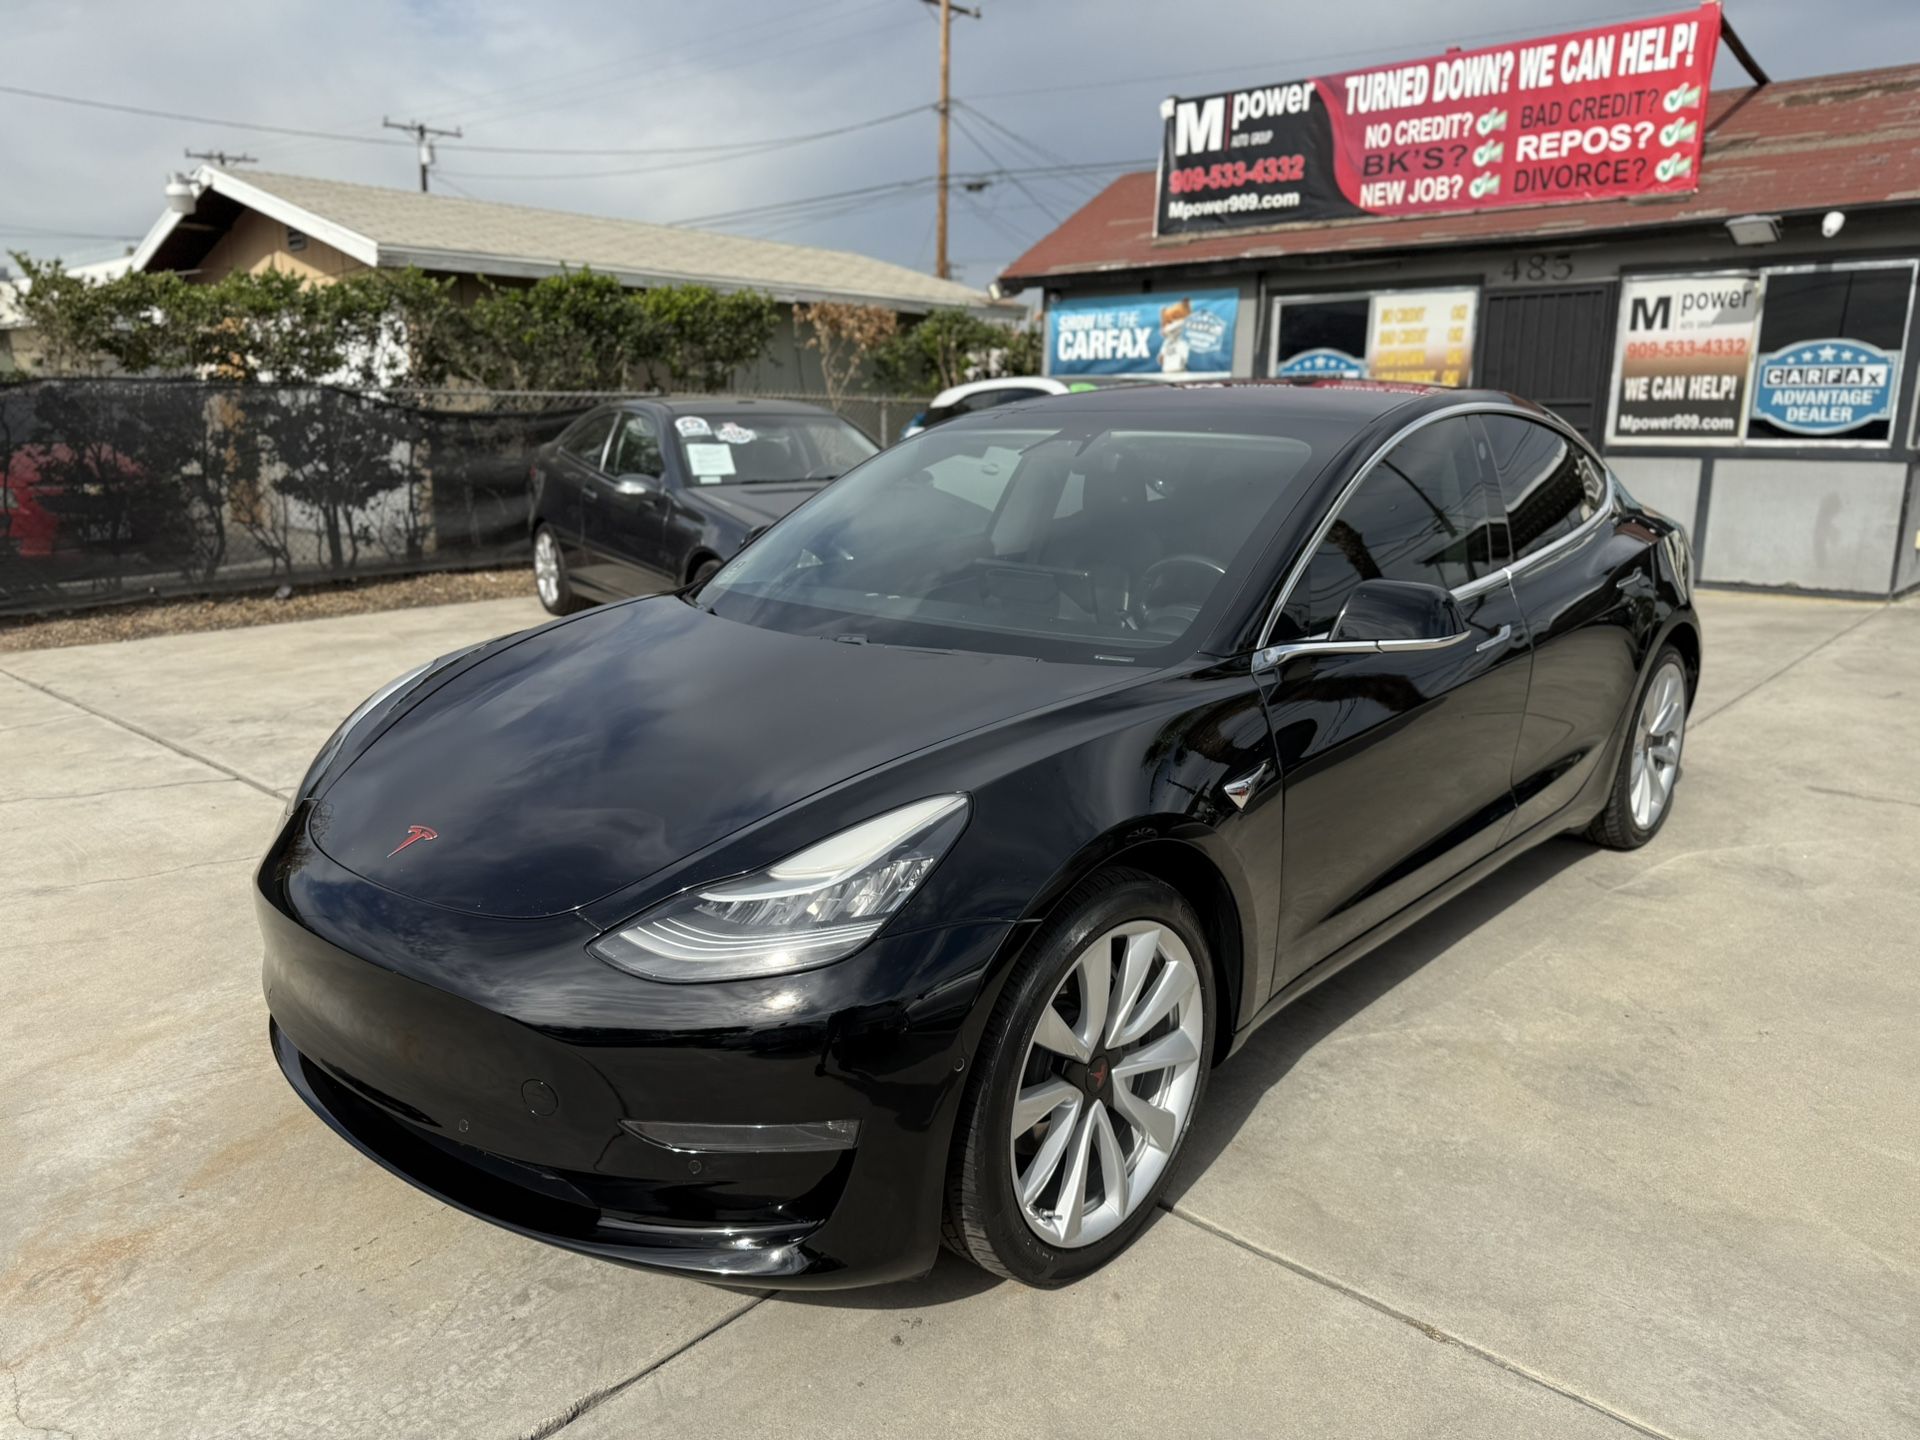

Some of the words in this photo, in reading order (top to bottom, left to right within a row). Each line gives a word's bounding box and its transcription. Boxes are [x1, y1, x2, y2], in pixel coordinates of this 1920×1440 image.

[1344, 65, 1429, 116] TURNED
[1432, 50, 1515, 103] DOWN?
[1518, 44, 1557, 91] WE
[1560, 34, 1615, 84] CAN
[1618, 21, 1698, 77] HELP!
[1175, 97, 1225, 156] M
[1231, 81, 1316, 131] power
[1520, 101, 1562, 129] BAD
[1568, 88, 1660, 122] CREDIT?
[1364, 122, 1392, 149] NO
[1394, 111, 1474, 147] CREDIT?
[1516, 121, 1655, 162] REPOS?
[1168, 154, 1305, 195] 909-533-4332
[1360, 180, 1406, 208] NEW
[1408, 174, 1464, 204] JOB?
[1513, 157, 1648, 194] DIVORCE?
[1168, 192, 1300, 221] Mpower909.com
[1502, 252, 1573, 282] 485
[1629, 296, 1672, 332] M
[1681, 288, 1751, 317] power
[1057, 326, 1152, 361] CARFAX
[1627, 338, 1746, 359] 909-533-4332
[1625, 376, 1650, 401] WE
[1651, 375, 1687, 400] CAN
[1688, 375, 1737, 400] HELP!
[1766, 367, 1882, 386] CARFAX
[1771, 389, 1873, 406] ADVANTAGE
[1785, 406, 1853, 422] DEALER
[1619, 414, 1734, 432] Mpower909.com
